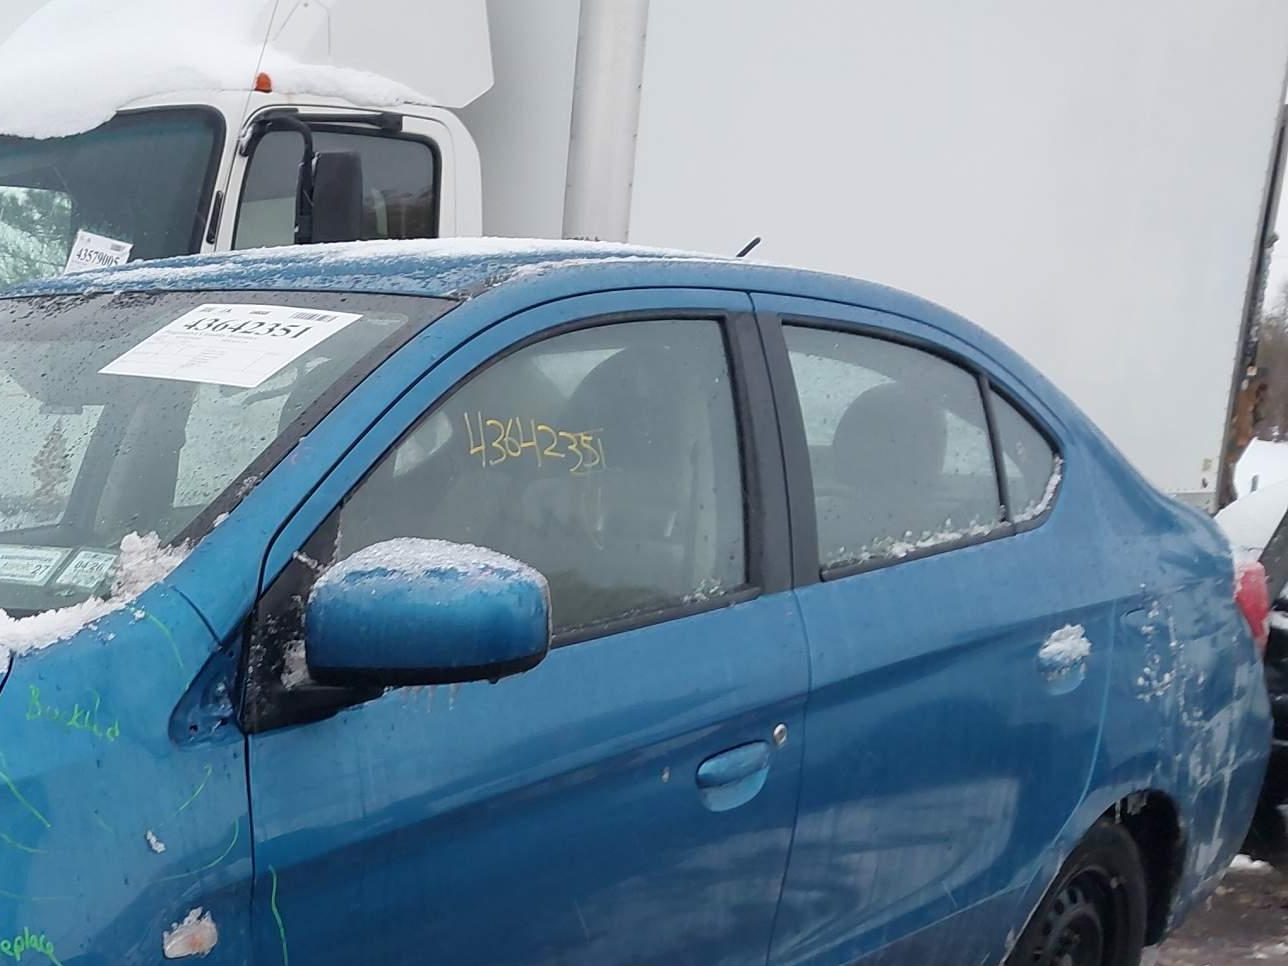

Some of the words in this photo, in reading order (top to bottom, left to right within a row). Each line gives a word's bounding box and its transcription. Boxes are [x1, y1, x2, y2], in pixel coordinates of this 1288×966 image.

[183, 317, 313, 339] 43642351
[464, 411, 607, 472] 43642351
[30, 563, 51, 576] 27
